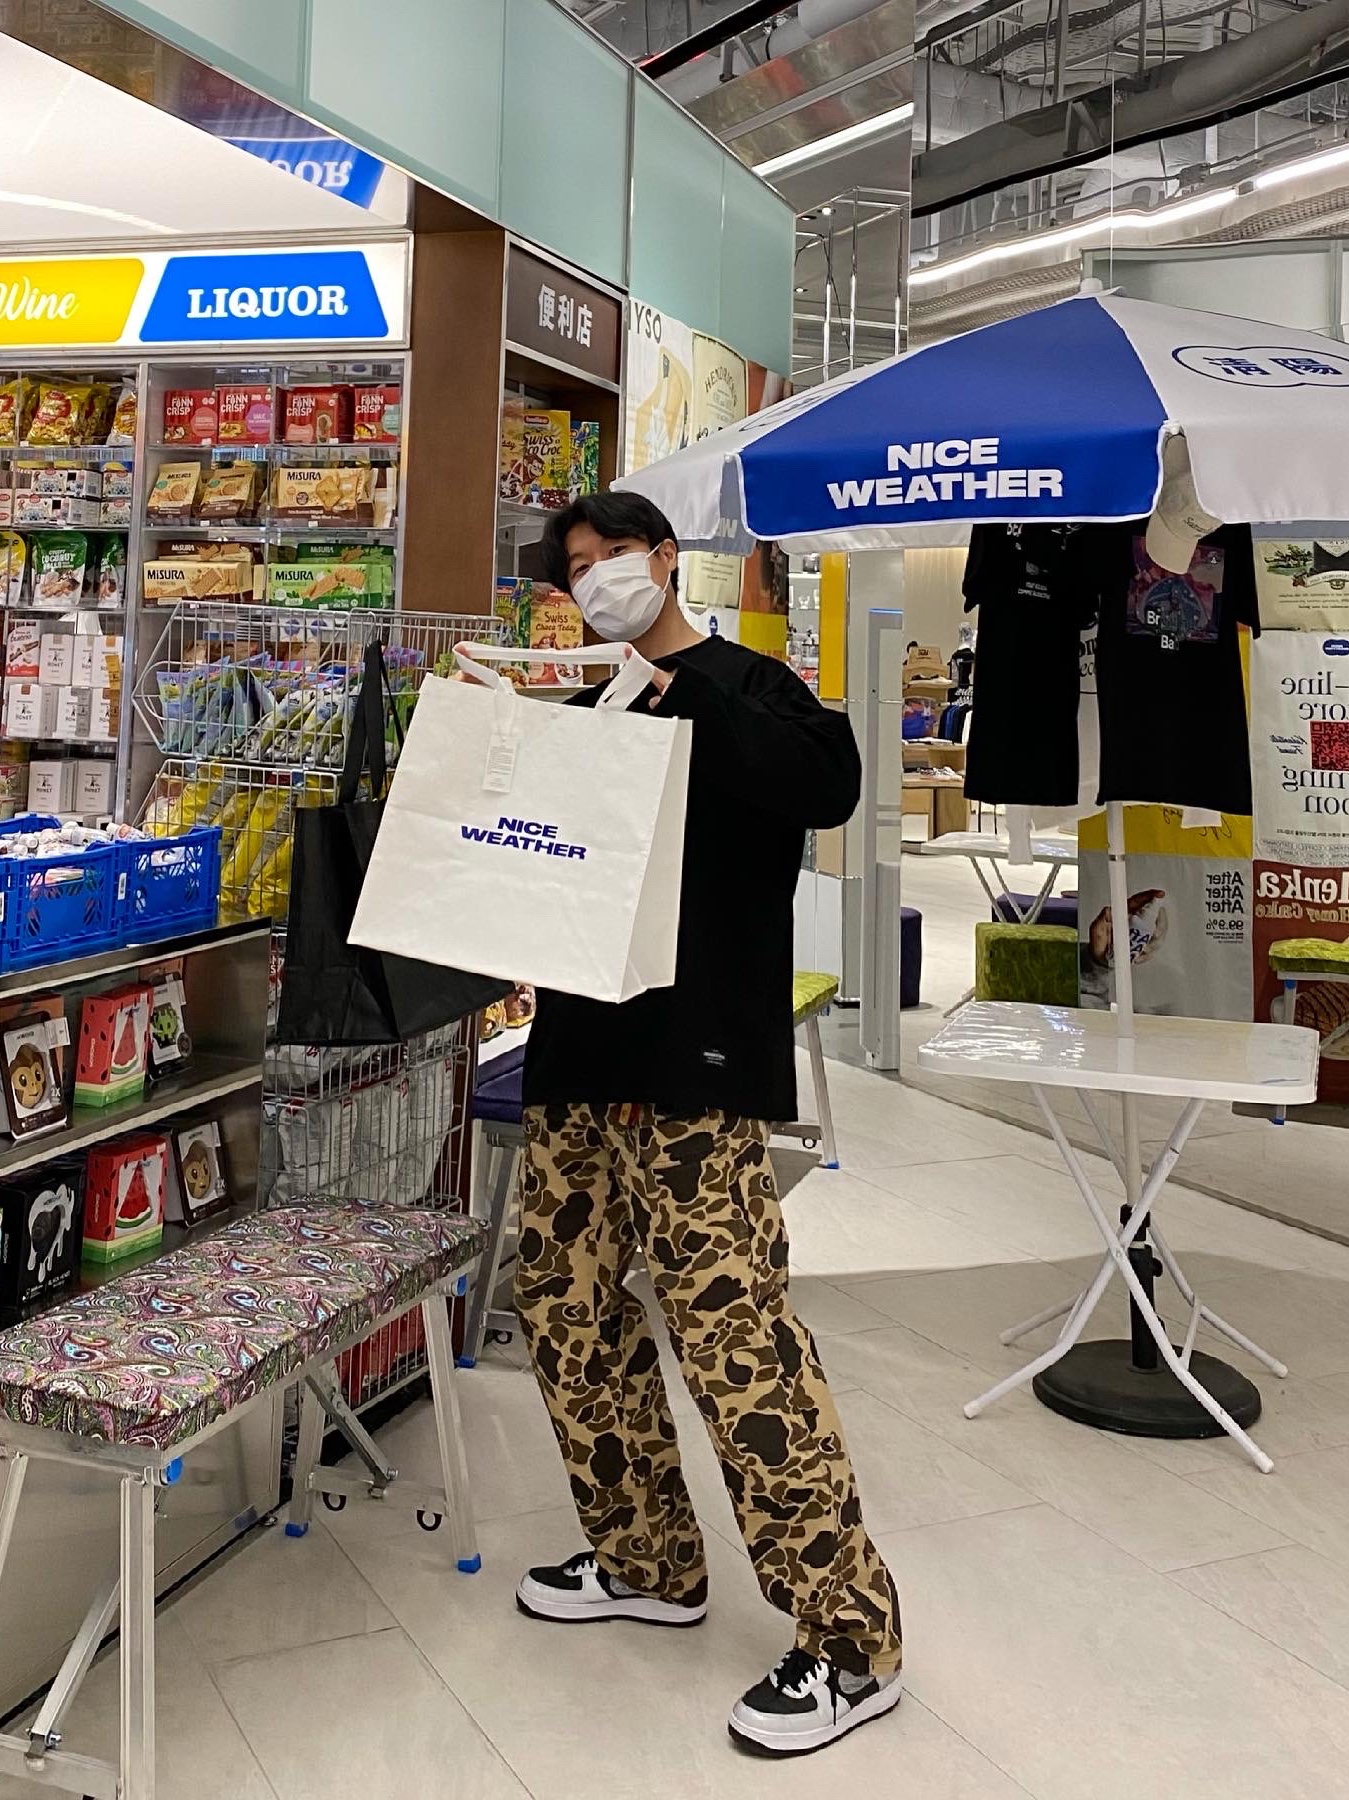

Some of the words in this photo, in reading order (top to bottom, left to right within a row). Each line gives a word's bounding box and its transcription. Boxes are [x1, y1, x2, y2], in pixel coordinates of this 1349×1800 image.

[187, 285, 349, 319] LIQUOR
[538, 283, 593, 348] 便利店
[166, 407, 191, 416] CRISP
[220, 403, 246, 413] CRISP
[286, 407, 313, 417] CRISP
[355, 405, 381, 414] CRISP
[523, 431, 555, 446] Swiss
[887, 437, 1000, 472] NICE
[826, 468, 1064, 510] WEATHER
[544, 611, 569, 624] Swiss
[1147, 610, 1161, 625] Br
[1160, 634, 1176, 650] Ba
[497, 816, 559, 839] NICE
[460, 825, 588, 861] WEATHER
